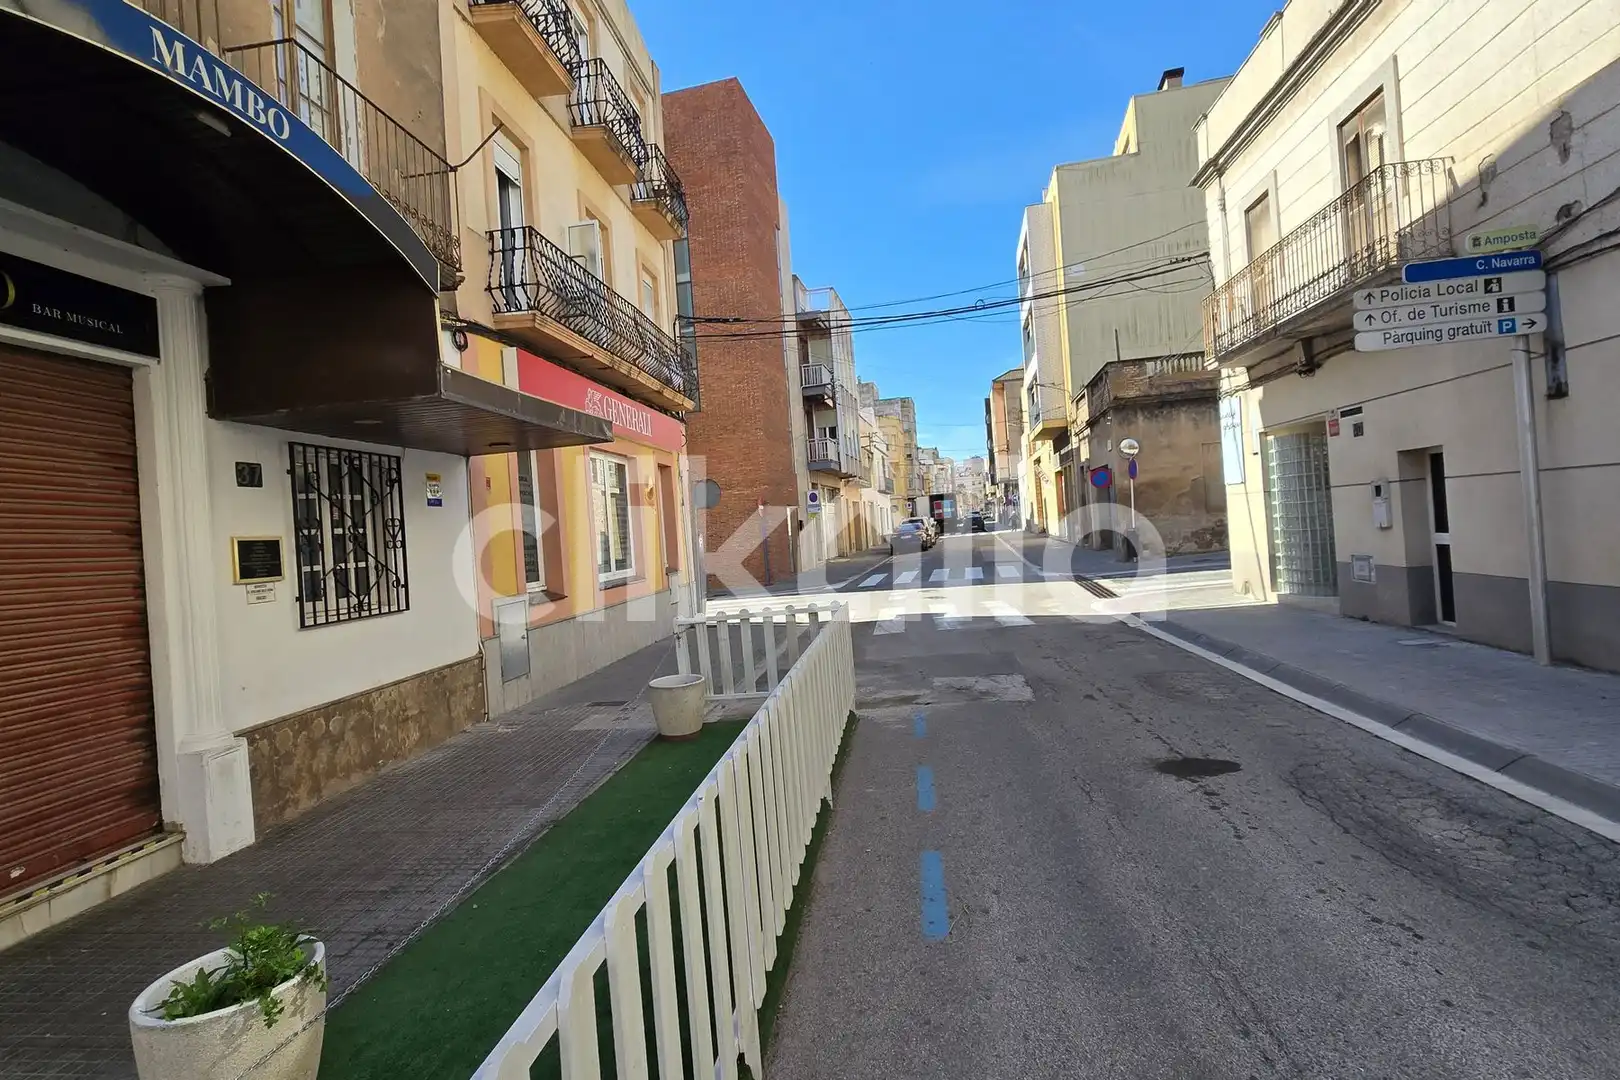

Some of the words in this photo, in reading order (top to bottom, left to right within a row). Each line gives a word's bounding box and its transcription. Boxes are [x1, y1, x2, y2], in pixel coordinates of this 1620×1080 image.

[149, 25, 290, 140] MAMBO
[1484, 230, 1537, 246] Amposta
[1476, 259, 1489, 270] C.
[1492, 255, 1536, 269] Navarra
[1380, 287, 1431, 302] Policia
[1437, 280, 1478, 296] Local
[32, 303, 62, 320] BAR
[66, 311, 124, 334] MUSICAL
[1381, 308, 1402, 324] Of.
[1407, 307, 1426, 321] de
[1431, 299, 1491, 318] Turisme
[1383, 324, 1443, 345] Pàrquing
[1447, 320, 1493, 340] gratuït
[603, 396, 653, 437] GENERALI
[237, 463, 261, 485] 37
